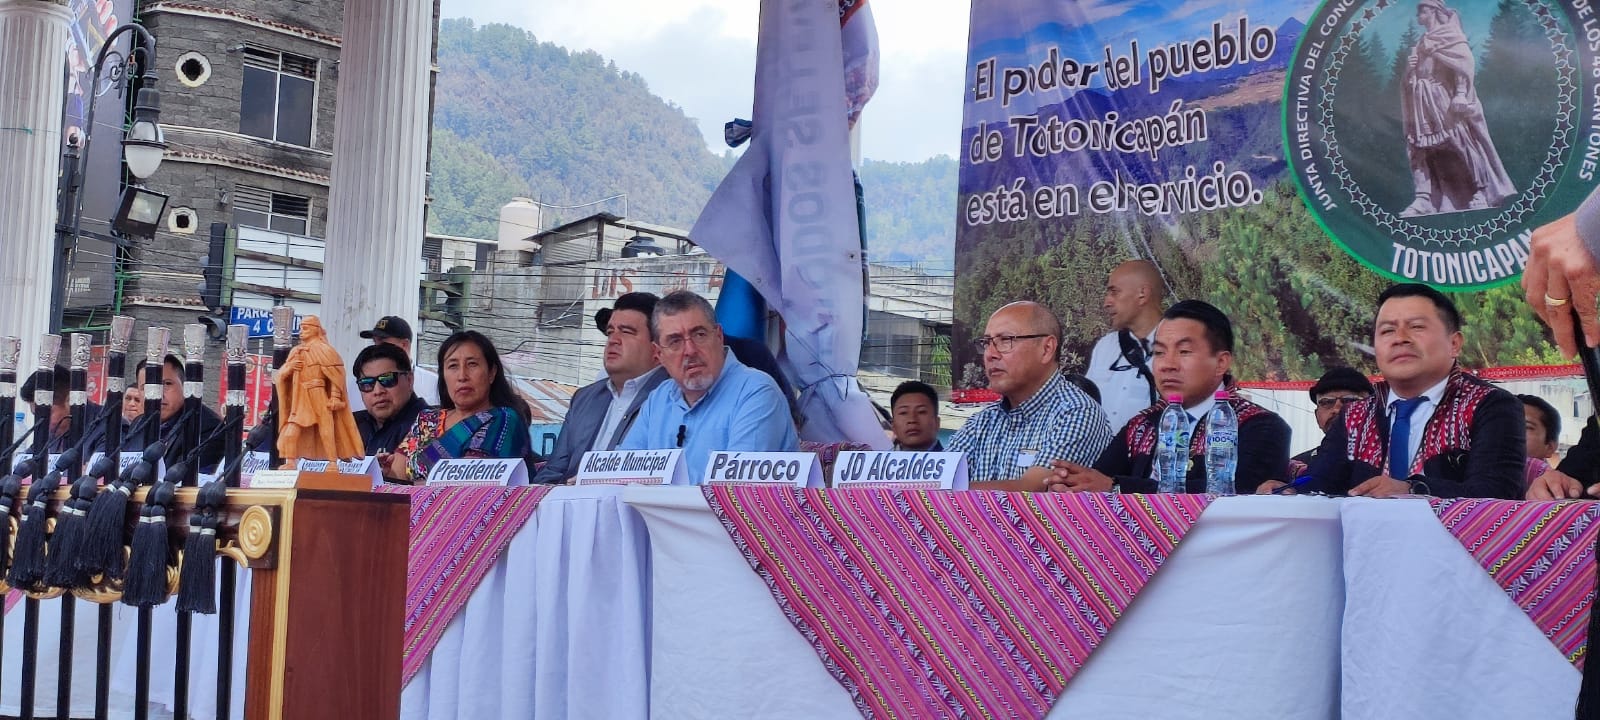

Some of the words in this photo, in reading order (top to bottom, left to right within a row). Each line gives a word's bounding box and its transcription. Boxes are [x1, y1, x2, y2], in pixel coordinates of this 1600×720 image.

[1583, 18, 1600, 52] LOS
[974, 57, 997, 102] El
[1104, 40, 1141, 91] del
[1149, 16, 1277, 94] pueblo
[1303, 40, 1326, 70] DEL
[1297, 74, 1313, 161] DIRECTIVA
[970, 120, 1003, 164] de
[966, 177, 1029, 227] está
[1033, 182, 1080, 221] en
[1305, 162, 1338, 211] JUNTA
[432, 459, 507, 481] Presidente
[584, 452, 621, 473] Alcalde
[621, 451, 671, 475] Municipal
[710, 453, 801, 481] Párroco
[841, 452, 865, 482] JD
[867, 452, 946, 481] Alcaldes
